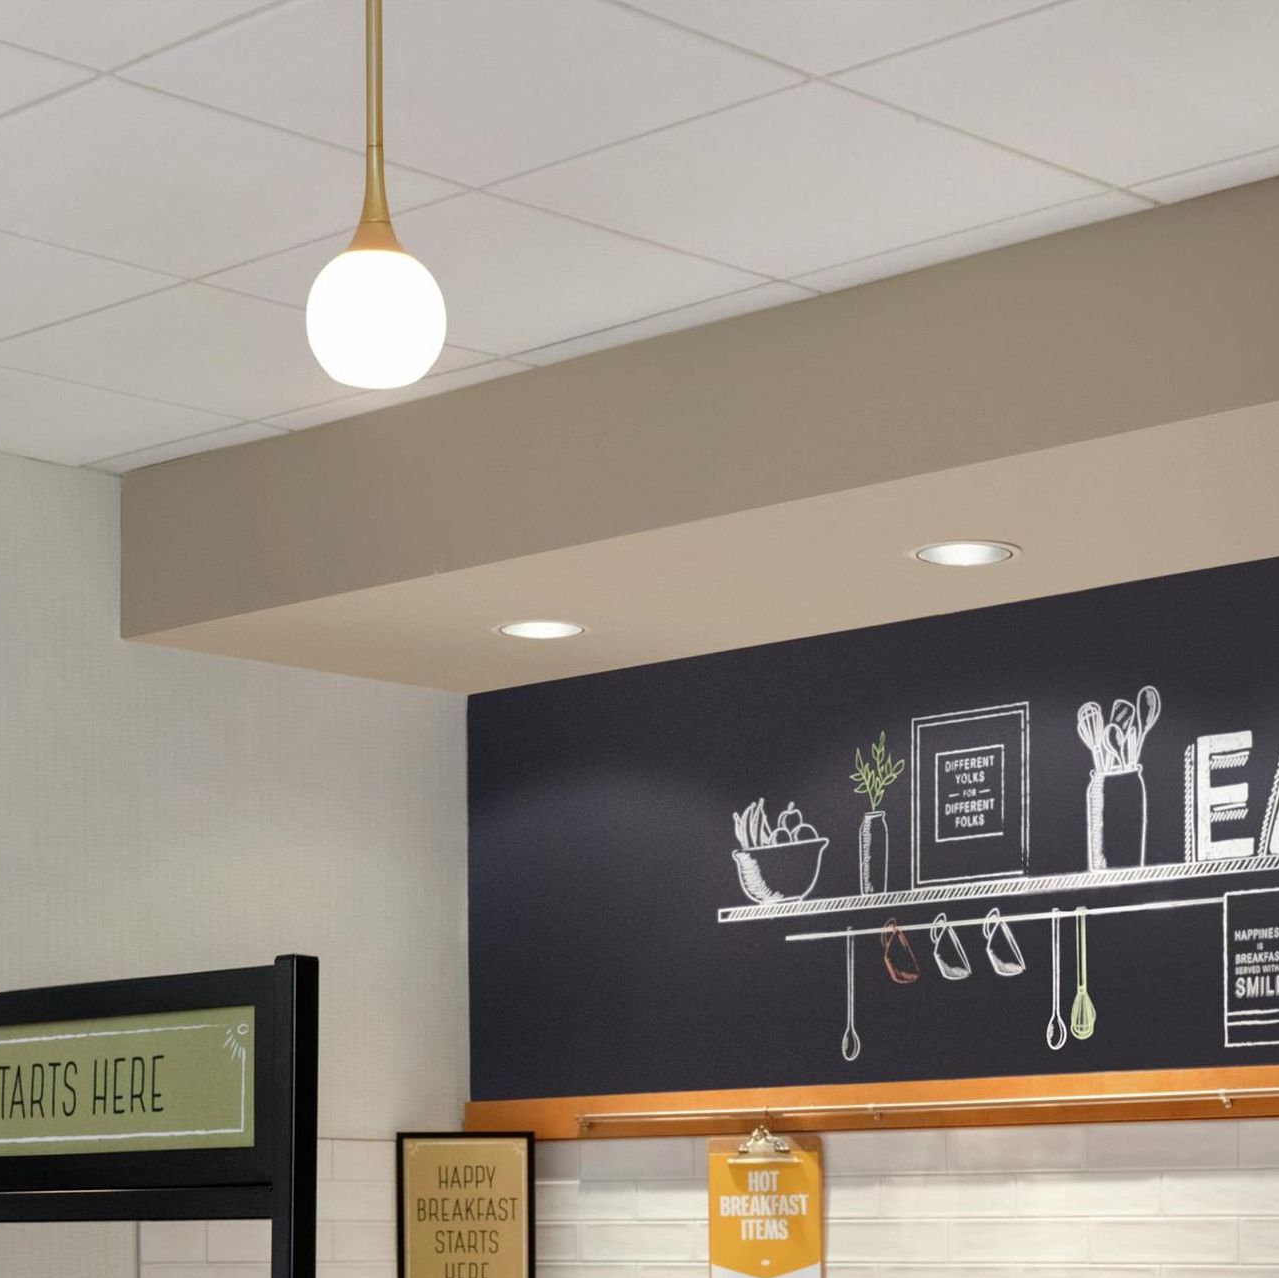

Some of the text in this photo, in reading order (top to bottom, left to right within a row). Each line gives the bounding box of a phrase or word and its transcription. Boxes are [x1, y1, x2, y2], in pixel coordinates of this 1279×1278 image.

[944, 755, 995, 773] DIFFERENT
[955, 770, 985, 784] YOLKS
[962, 788, 977, 798] FOR
[944, 798, 995, 816] DIFFERENT
[954, 814, 985, 828] FOLKS
[1256, 942, 1264, 950] IS
[1235, 965, 1261, 976] SERVED
[1262, 963, 1279, 973] WITH
[92, 1054, 165, 1116] HERE
[438, 1164, 496, 1189] HAPPY
[748, 1170, 780, 1193] HOT
[417, 1197, 519, 1222] BREAKFAST
[720, 1194, 809, 1216] BREAKFAST
[741, 1218, 789, 1241] ITEMS
[434, 1229, 500, 1254] STARTS
